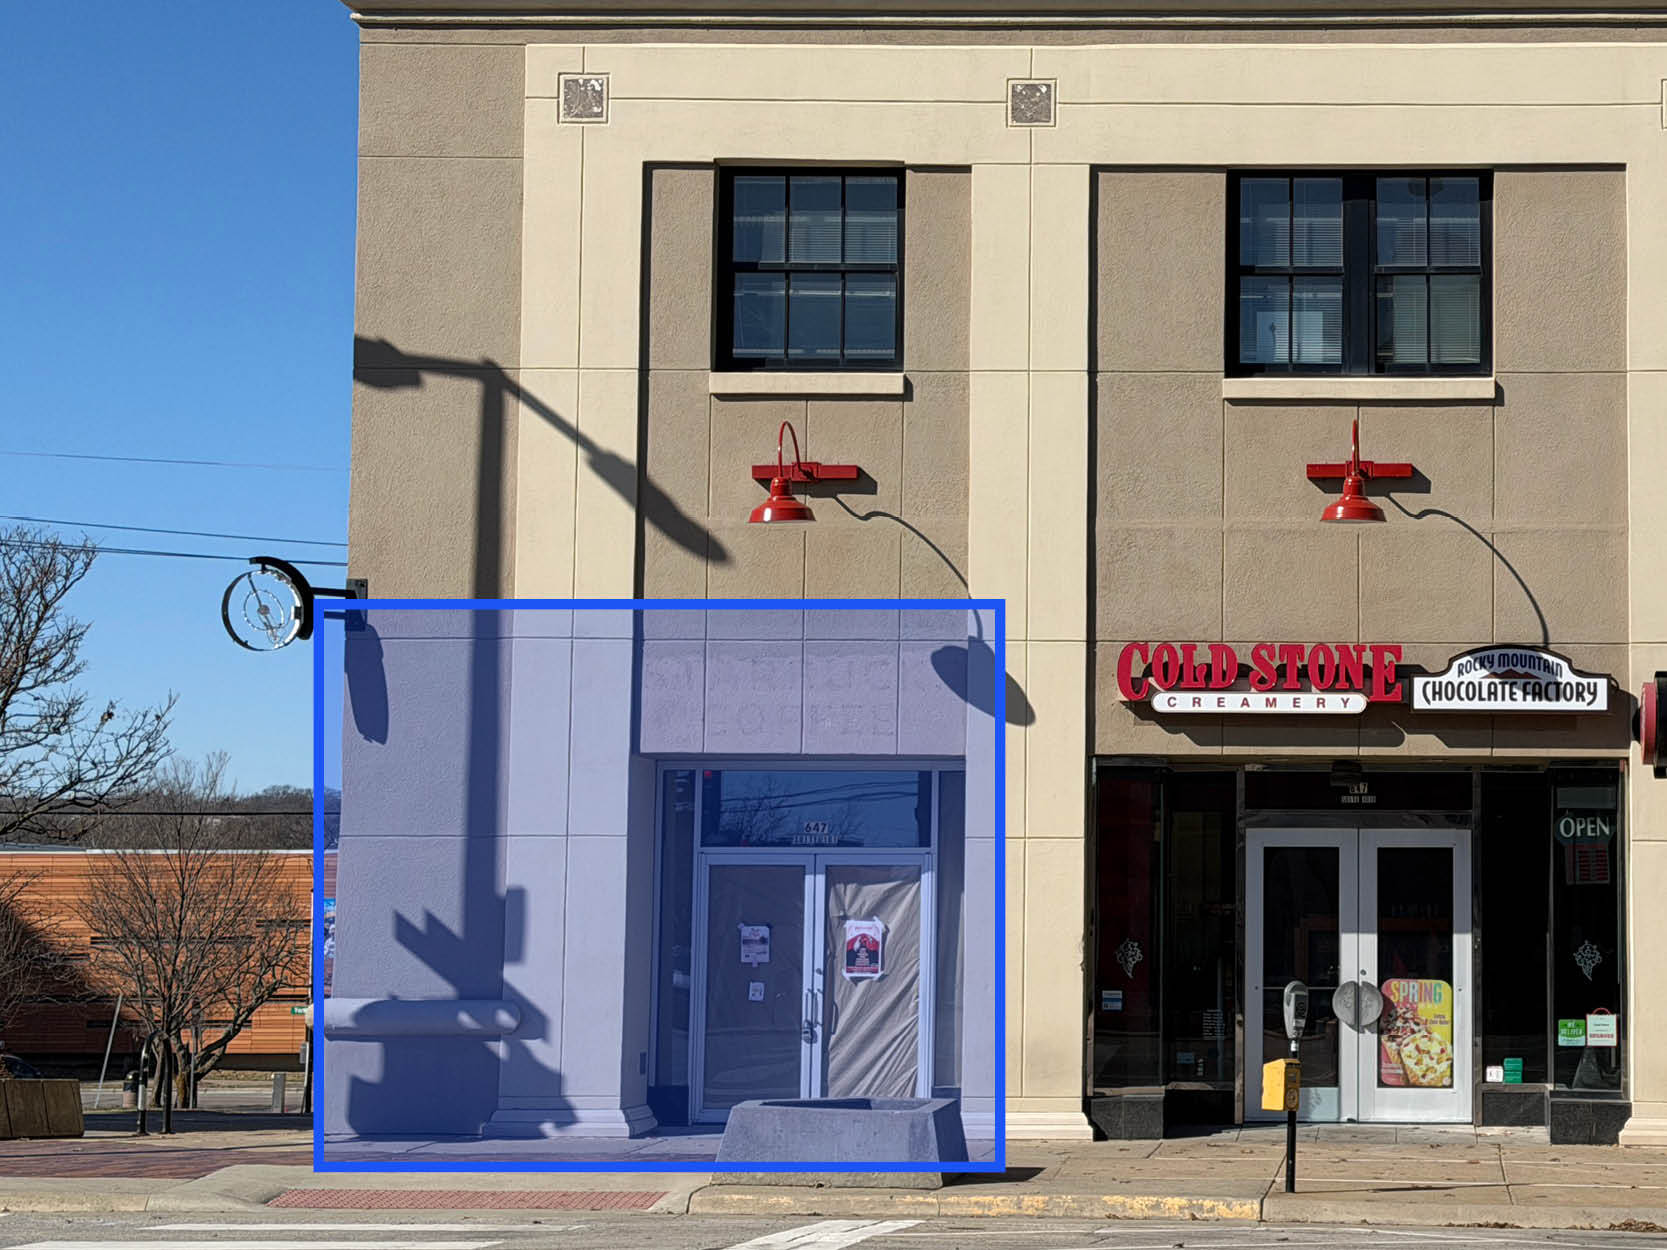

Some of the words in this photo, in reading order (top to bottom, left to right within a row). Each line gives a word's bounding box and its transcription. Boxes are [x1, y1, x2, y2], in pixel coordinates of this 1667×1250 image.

[1117, 643, 1238, 701] COLD
[1250, 643, 1402, 702] STONE
[1457, 653, 1494, 678] ROCKY
[1498, 652, 1563, 678] MOUNTAIN
[1167, 696, 1351, 709] CREAMERY
[1422, 681, 1519, 705] CHOCOLATE
[1522, 681, 1597, 706] FACTORY
[804, 822, 827, 833] 647
[1560, 816, 1610, 838] OPEN
[1391, 981, 1443, 1004] SPRING
